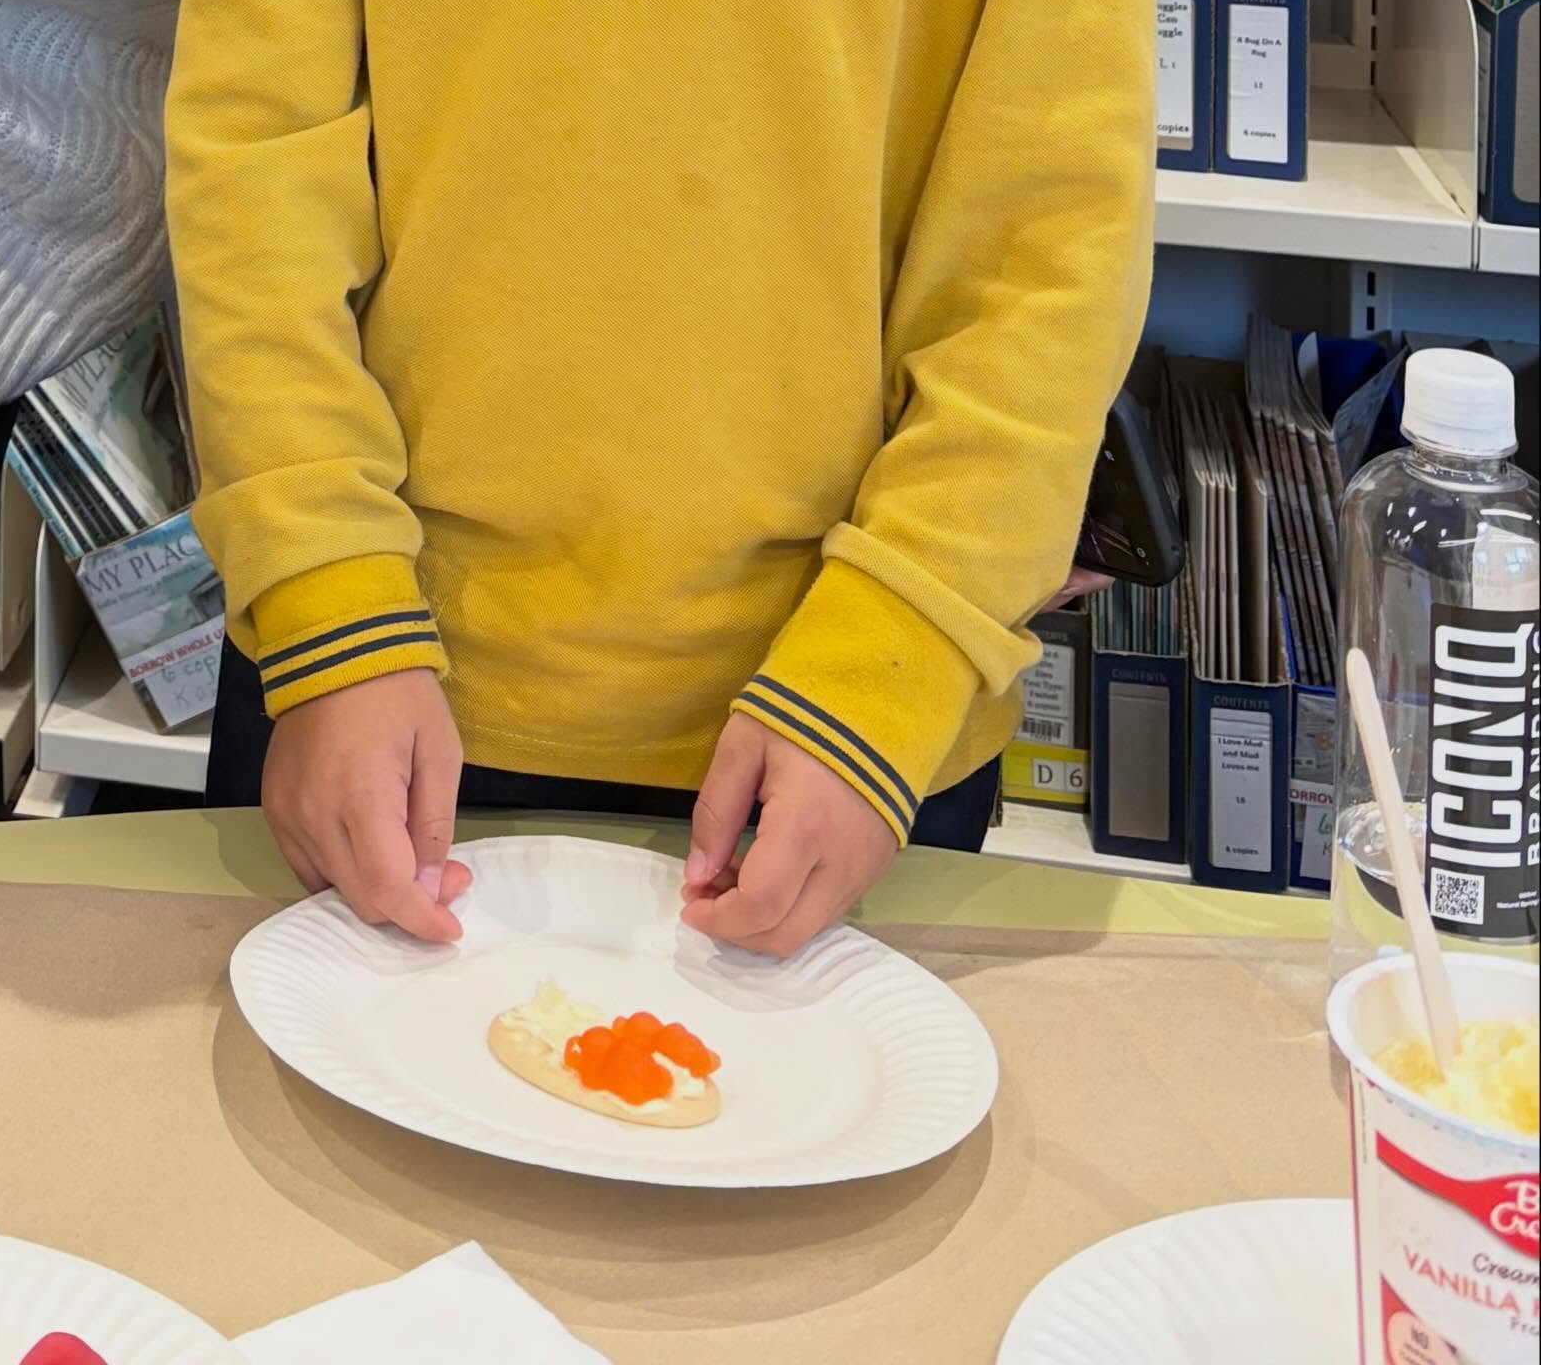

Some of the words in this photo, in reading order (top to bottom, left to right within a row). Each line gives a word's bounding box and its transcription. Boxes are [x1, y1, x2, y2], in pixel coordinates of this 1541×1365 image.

[1244, 37, 1260, 46] Bug
[1251, 49, 1267, 58] Rug
[1250, 131, 1276, 139] copies
[82, 563, 124, 596] MY
[128, 533, 198, 580] PLAC
[130, 650, 176, 679] BORROW
[177, 633, 214, 659] WHOLE
[1213, 696, 1269, 709] CONTENTS
[1223, 738, 1242, 746] Love
[1244, 739, 1264, 747] Mud
[1430, 623, 1535, 867] ICONIQ
[1240, 751, 1259, 759] Mud
[1222, 762, 1245, 771] Loves
[1038, 764, 1054, 785] D
[1070, 768, 1084, 788] 6
[1290, 788, 1333, 805] ORRO
[1232, 848, 1259, 856] copies
[1403, 1244, 1521, 1317] VANILLA
